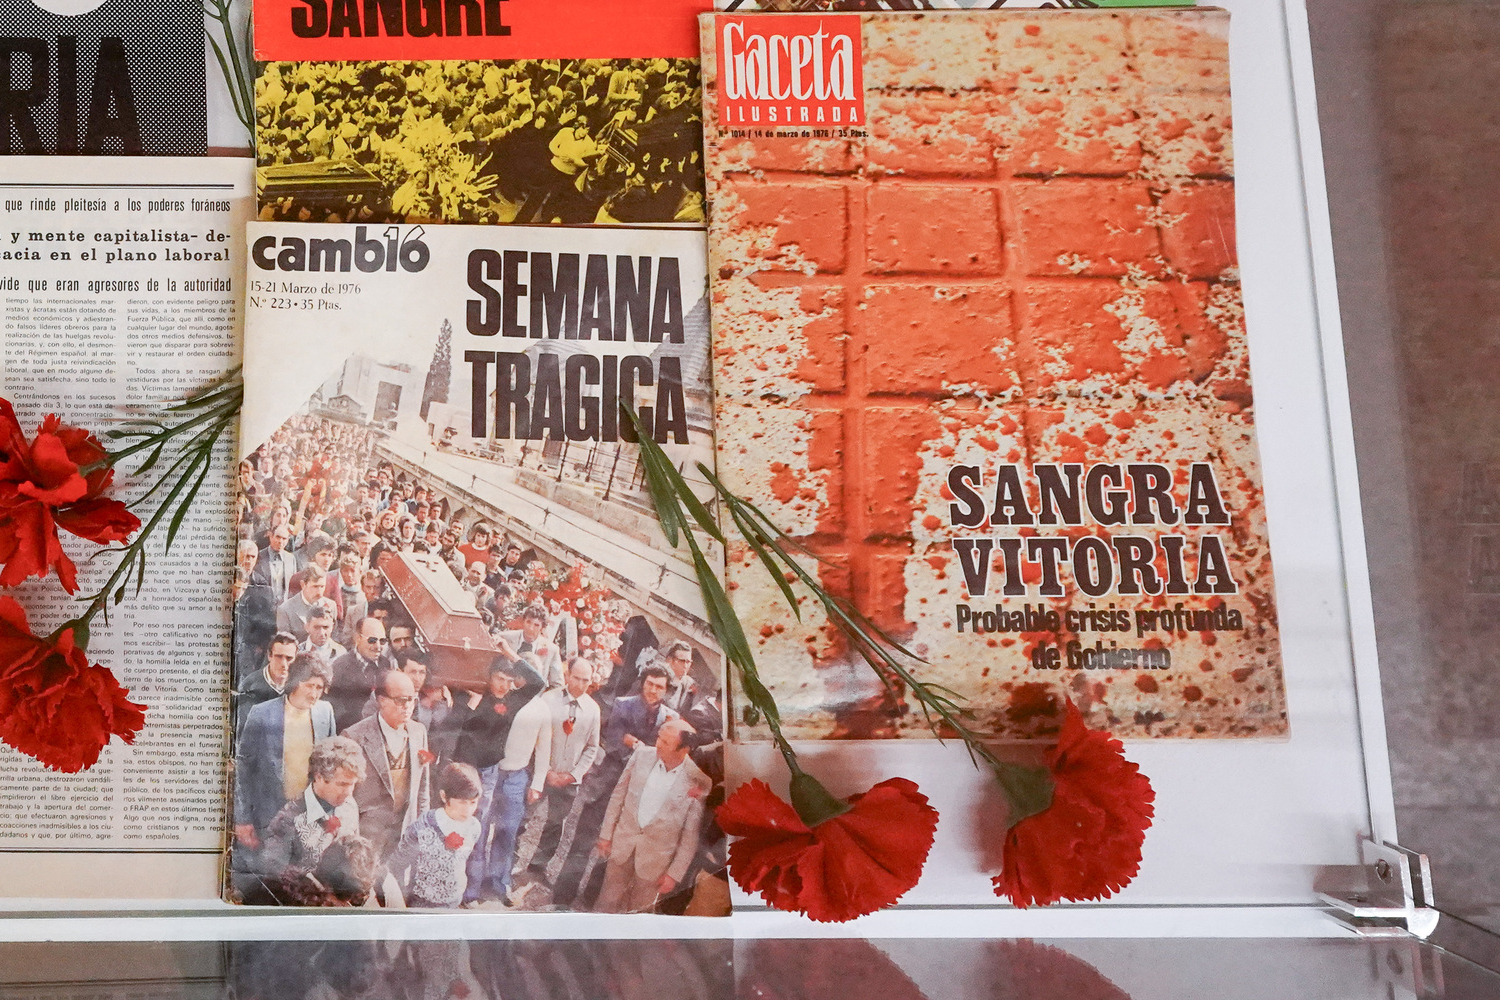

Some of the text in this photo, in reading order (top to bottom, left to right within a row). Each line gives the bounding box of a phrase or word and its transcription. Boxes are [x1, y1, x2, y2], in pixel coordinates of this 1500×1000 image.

[722, 21, 857, 102] Gaceta
[727, 106, 858, 122] ILUSTRADA
[5, 200, 22, 213] que
[30, 198, 56, 211] rinde
[64, 198, 107, 213] pleitesía
[114, 201, 120, 211] a
[127, 199, 142, 212] los
[148, 199, 185, 213] poderes
[191, 199, 231, 212] foráneos
[11, 231, 21, 244] y
[28, 231, 85, 242] mente
[205, 229, 231, 242] de-
[50, 250, 71, 261] en
[80, 248, 97, 261] el
[105, 248, 157, 264] plano
[165, 248, 230, 262] laboral
[250, 281, 361, 295] 15-21 Marzo de 1976
[466, 249, 684, 344] SEMANA
[464, 350, 690, 444] TRAGICA
[947, 462, 1232, 528] SANGRA
[952, 535, 1239, 597] VITORIA
[956, 603, 1243, 638] Probable crisis profunda
[1031, 641, 1171, 671] de Gobierno
